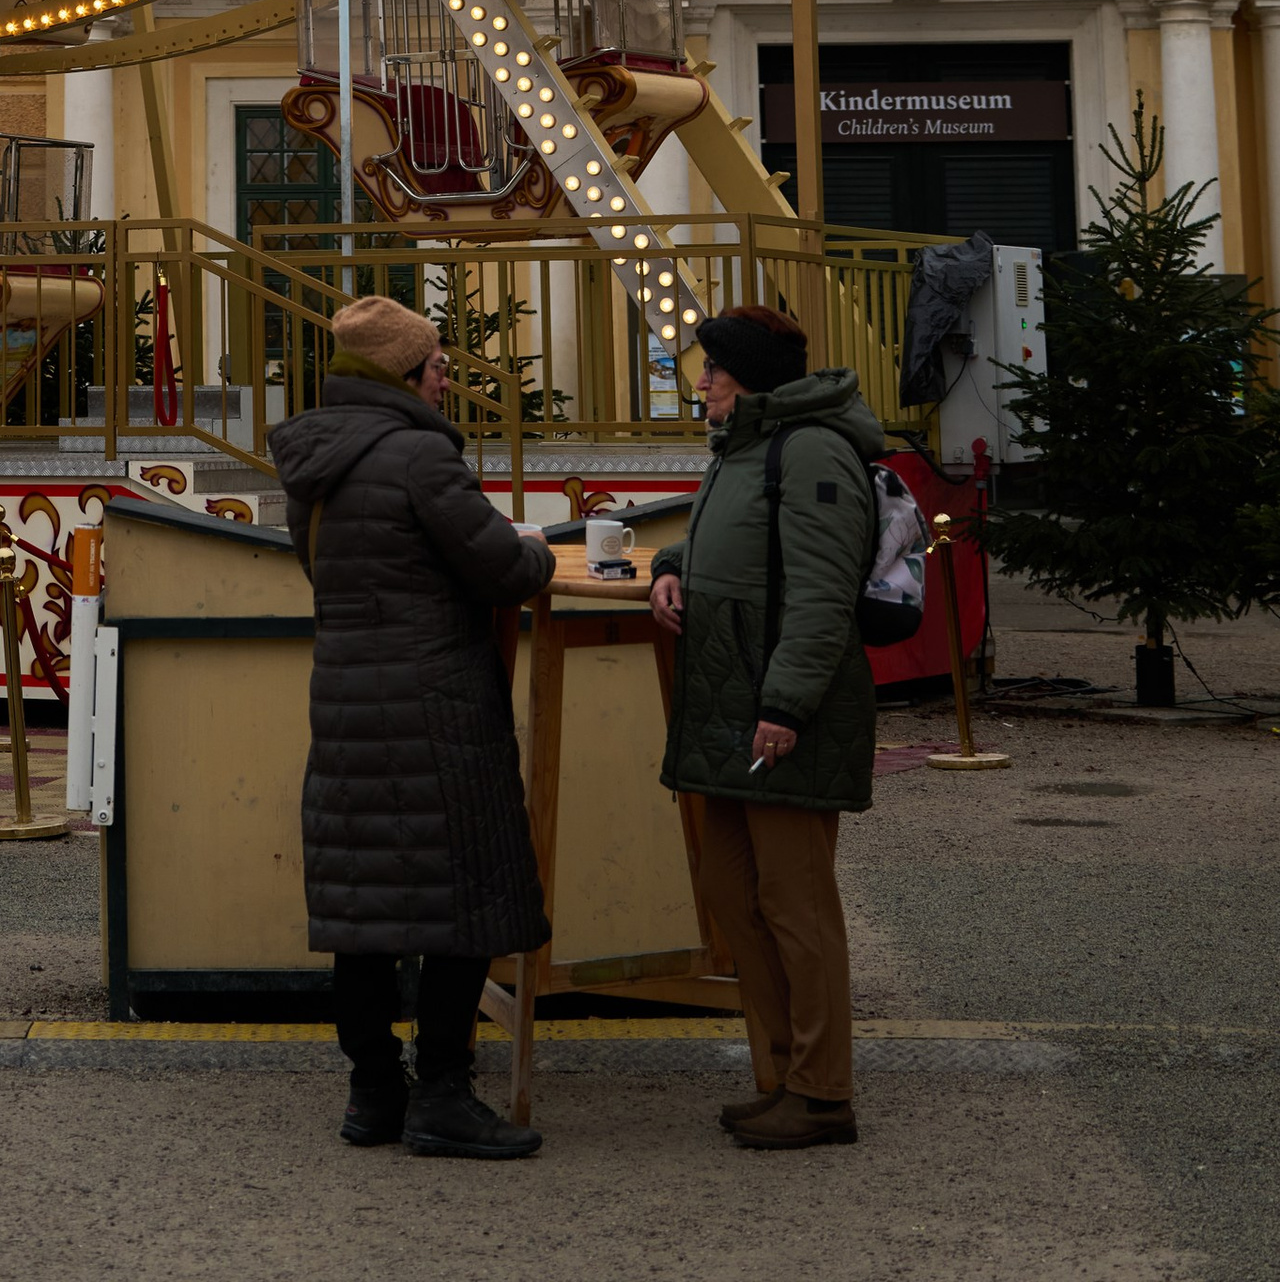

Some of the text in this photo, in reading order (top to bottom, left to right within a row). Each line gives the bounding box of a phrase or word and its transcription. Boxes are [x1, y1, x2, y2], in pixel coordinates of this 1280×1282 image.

[820, 89, 1012, 111] Kindermuseum
[838, 118, 995, 135] Children's Museum
